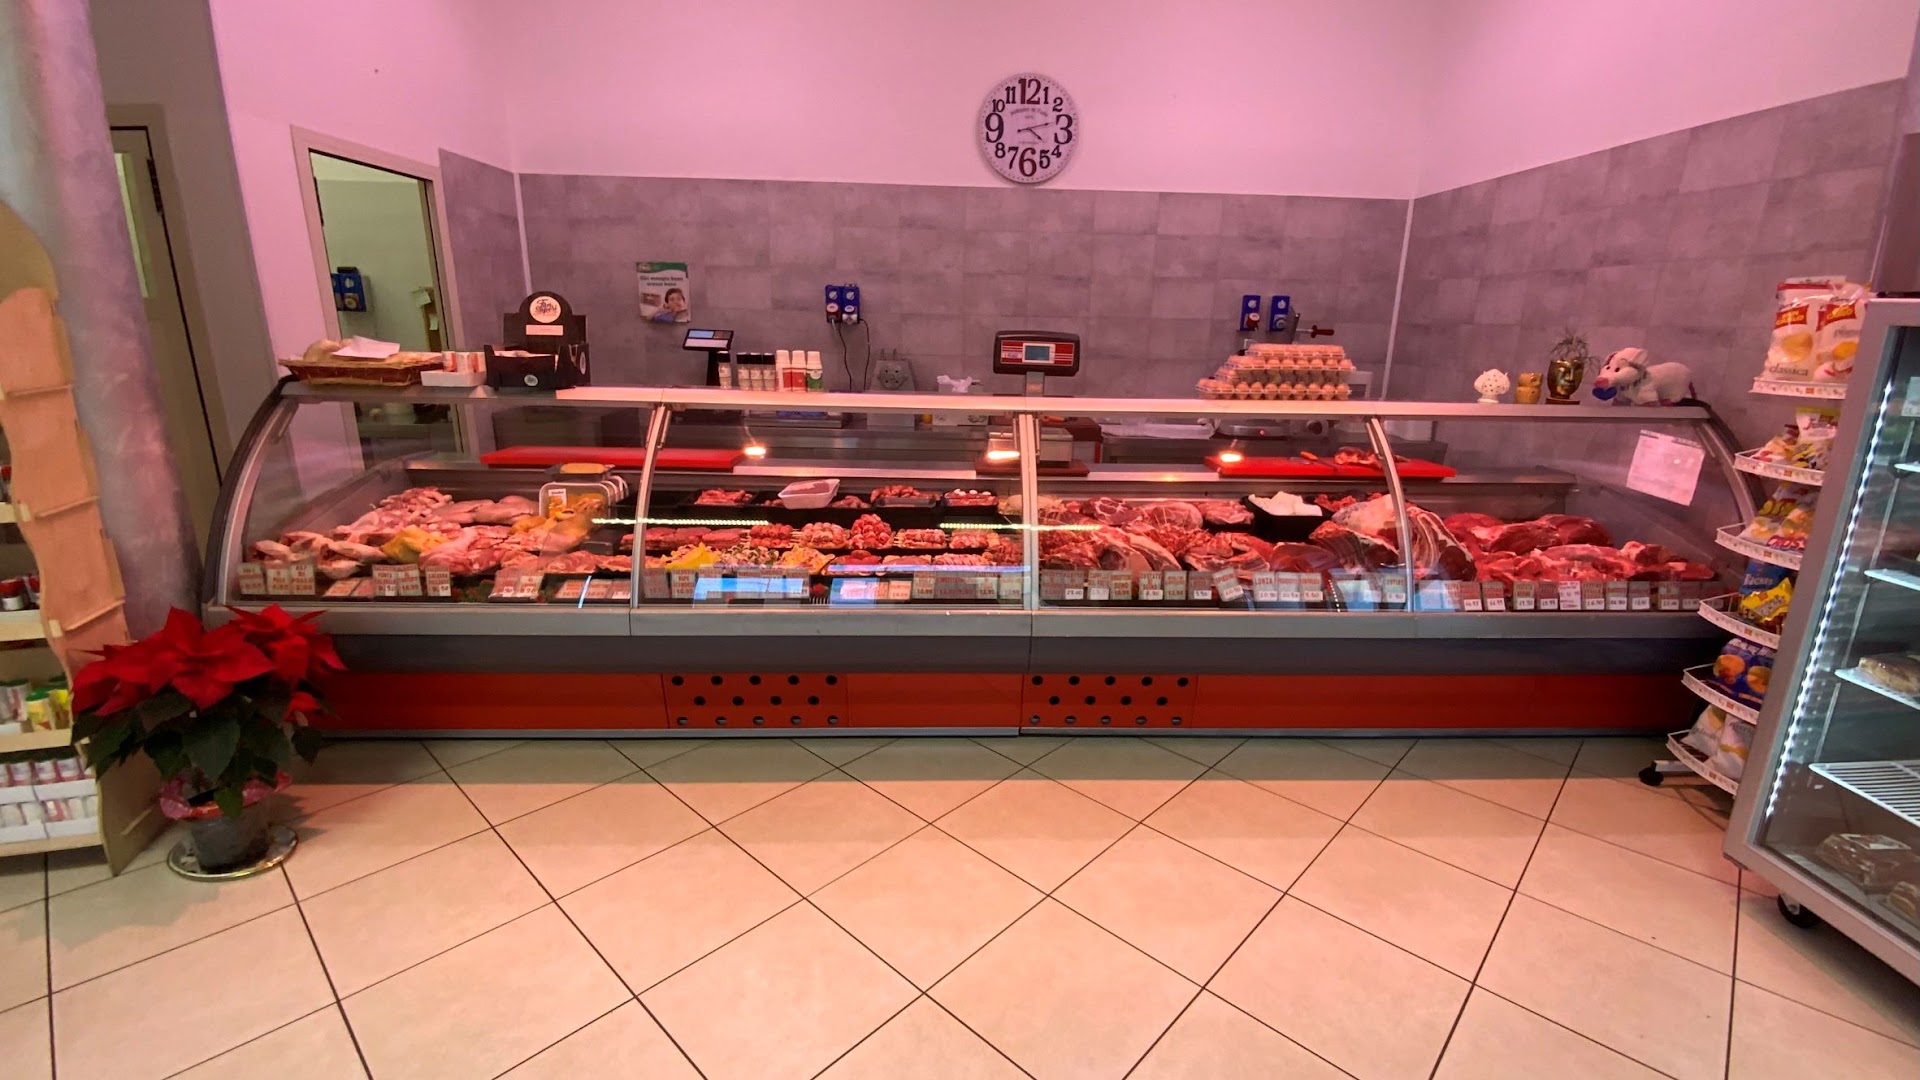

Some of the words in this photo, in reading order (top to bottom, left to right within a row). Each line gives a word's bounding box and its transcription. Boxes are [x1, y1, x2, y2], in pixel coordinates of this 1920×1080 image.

[1005, 86, 1016, 104] 11
[1018, 78, 1041, 105] 12
[1043, 86, 1049, 104] 1
[992, 99, 1005, 112] 10
[1052, 97, 1063, 112] 2
[985, 112, 1004, 143] 9
[1054, 114, 1073, 145] 3
[995, 142, 1006, 158] 8
[1007, 146, 1019, 169] 7
[1039, 149, 1051, 169] 5
[1051, 145, 1062, 158] 4
[1018, 147, 1037, 177] 6
